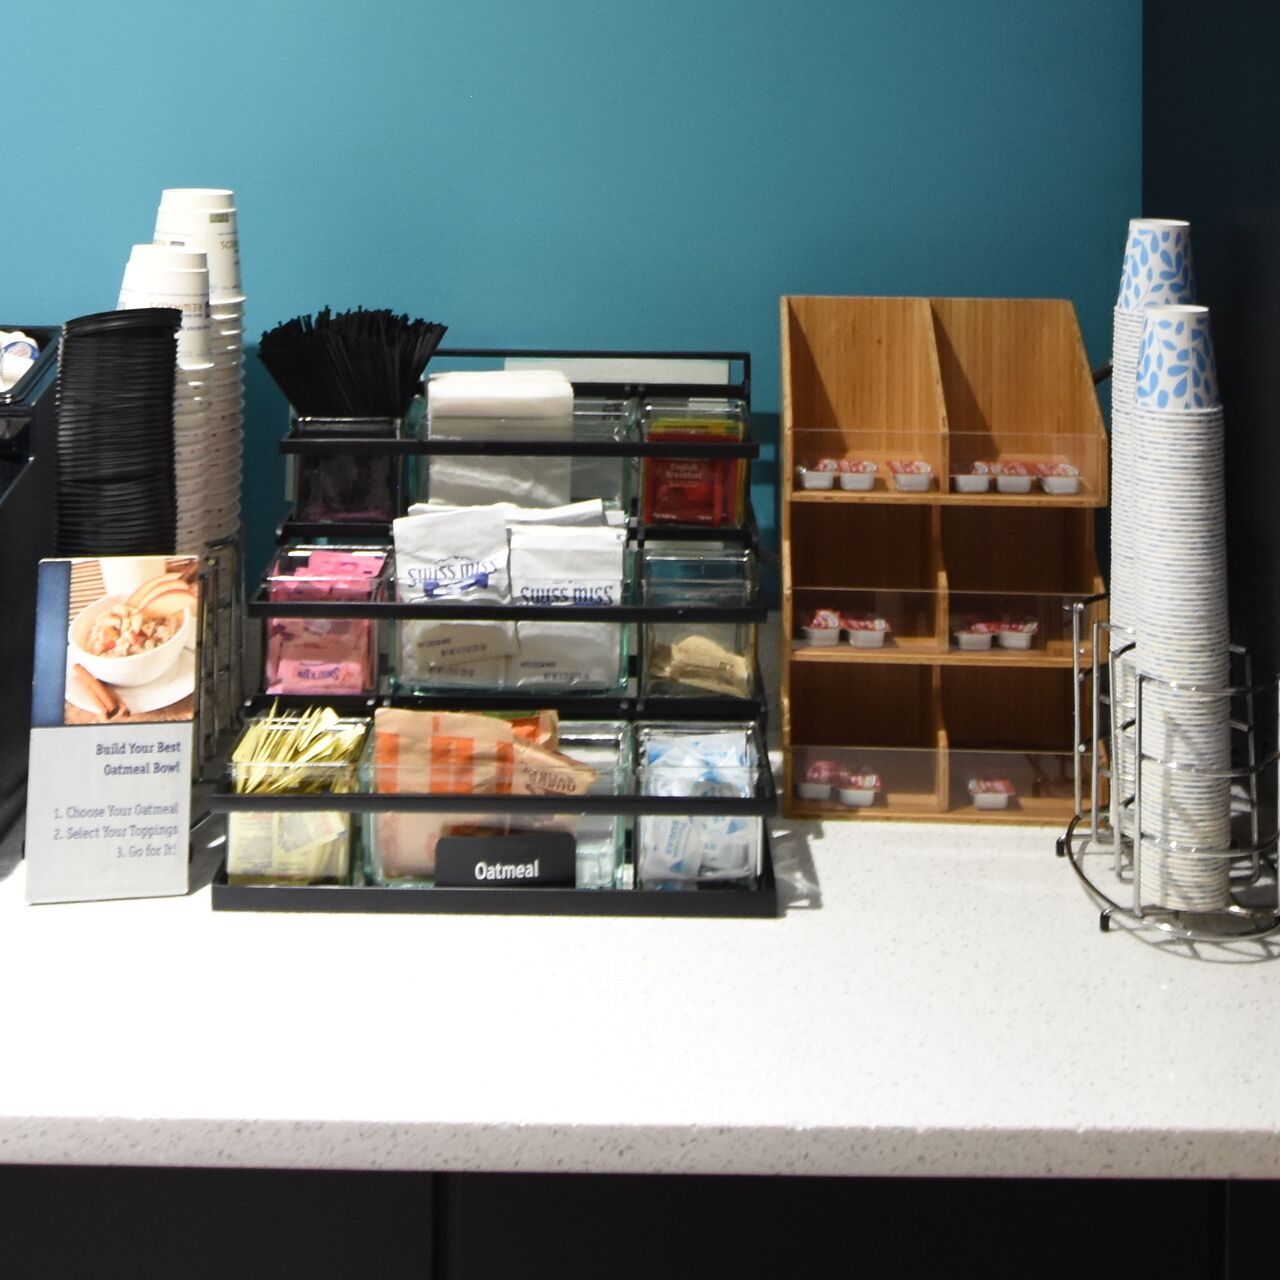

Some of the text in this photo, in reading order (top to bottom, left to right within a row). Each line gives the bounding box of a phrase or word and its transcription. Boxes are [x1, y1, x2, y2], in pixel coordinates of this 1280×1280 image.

[95, 741, 182, 756] Build Your Best
[103, 760, 181, 776] Oatmeal Bowl
[53, 802, 180, 820] 1. Choose Your Oatmeal
[53, 823, 179, 841] 2. Select Your Toppings
[116, 842, 178, 859] 3. Go for It!
[473, 858, 540, 881] Oatmeal
